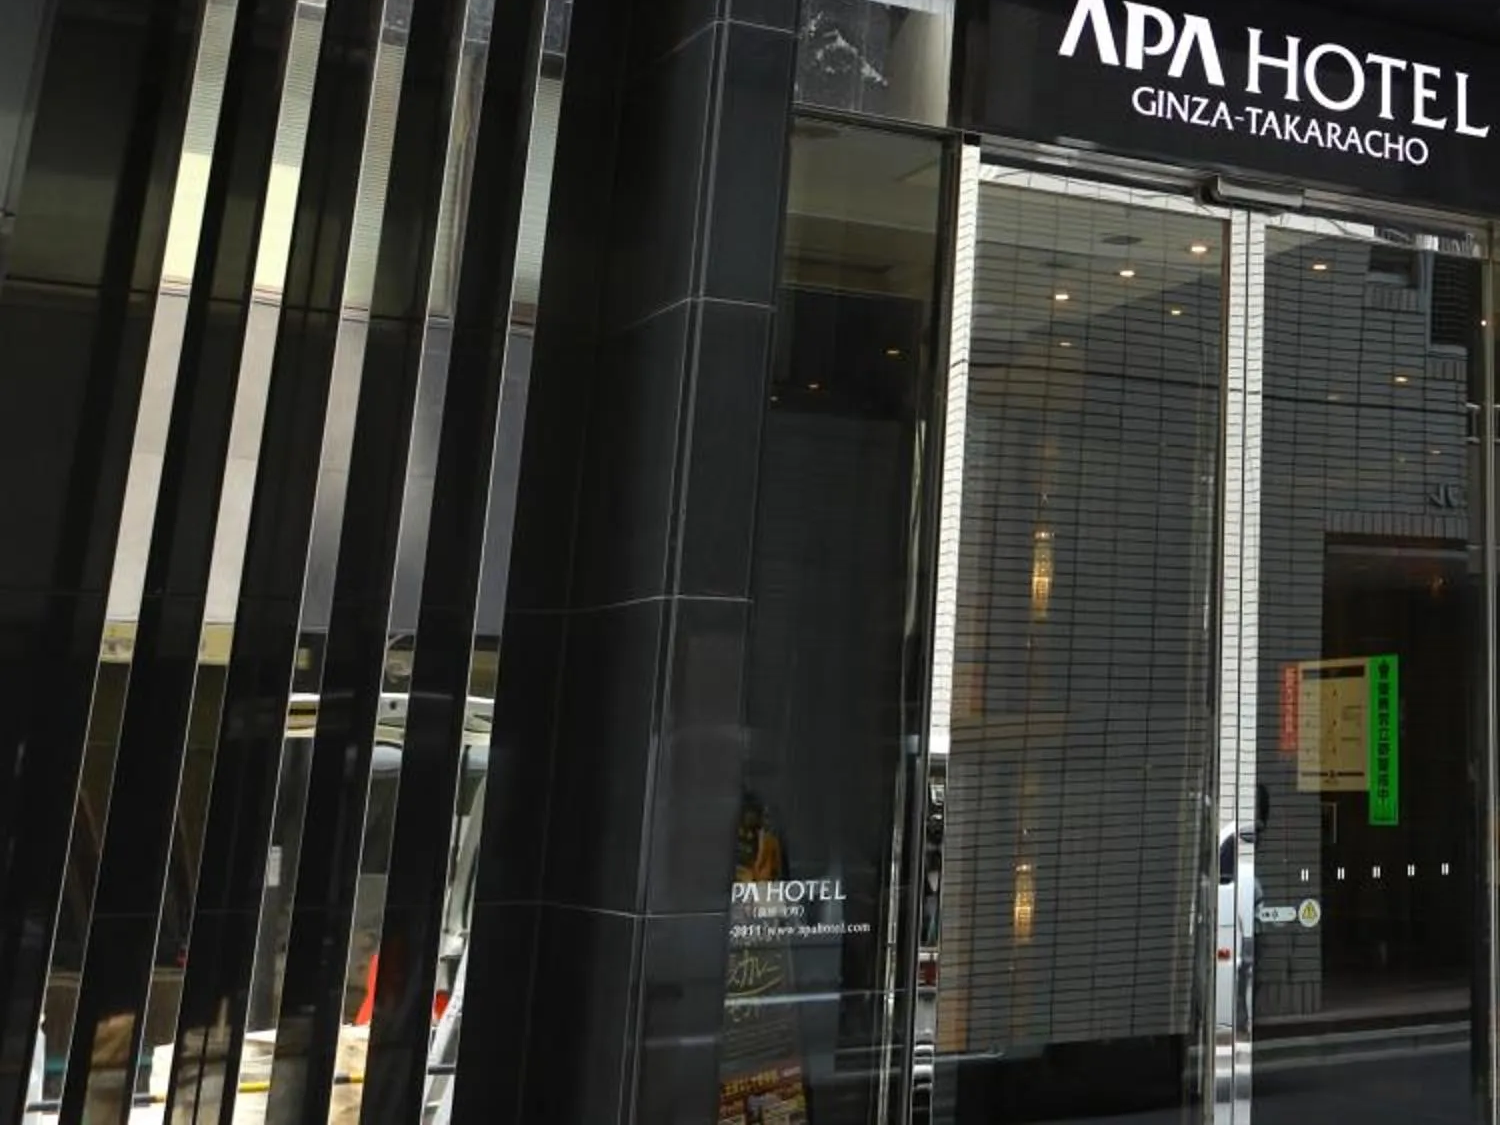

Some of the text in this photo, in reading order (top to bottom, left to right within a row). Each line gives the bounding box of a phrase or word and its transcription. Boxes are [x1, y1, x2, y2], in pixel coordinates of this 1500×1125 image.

[1246, 26, 1490, 139] HOTEL
[1131, 86, 1429, 166] GINZA-TAKARACHO
[766, 879, 847, 902] HOTEL
